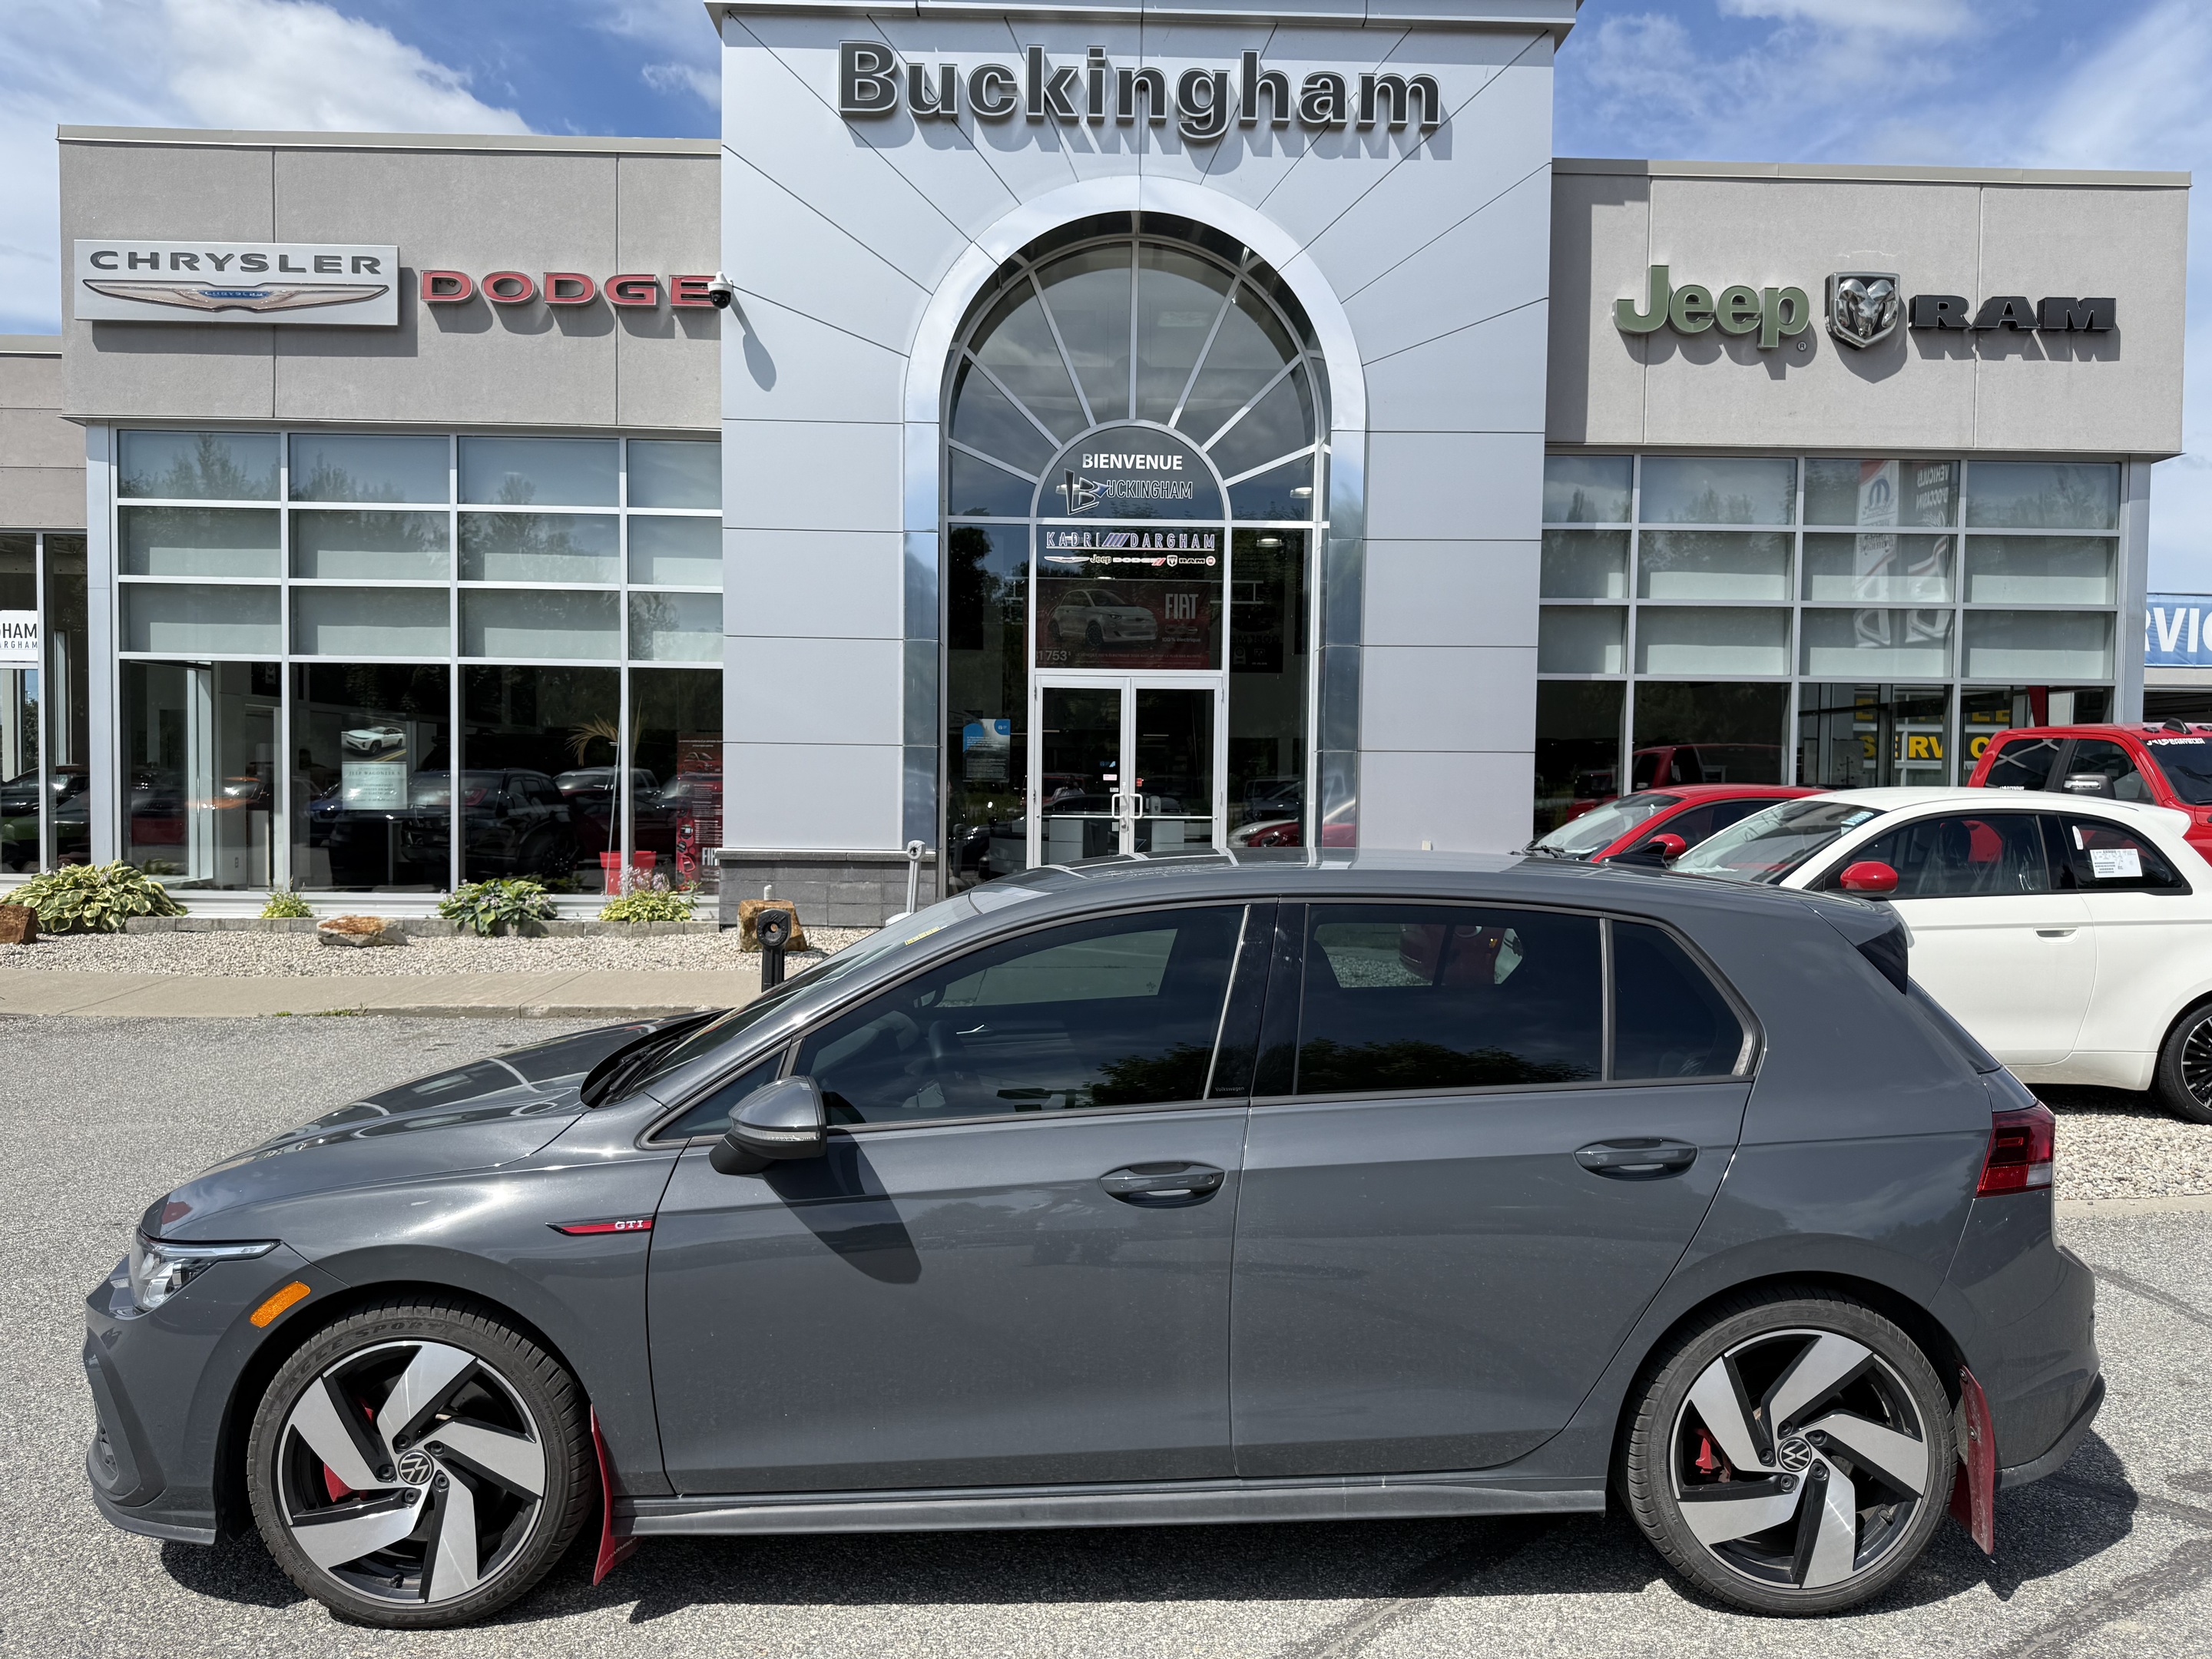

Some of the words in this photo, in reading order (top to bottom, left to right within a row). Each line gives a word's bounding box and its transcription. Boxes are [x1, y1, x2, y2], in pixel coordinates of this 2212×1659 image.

[839, 40, 1441, 143] Buckingham
[90, 250, 382, 275] CHRYSLER
[420, 270, 719, 309] DODGE
[1613, 265, 1810, 349] Jeep
[1909, 294, 2117, 333] RAM
[1082, 453, 1183, 470] BIENVENUE
[1046, 532, 1101, 547] KADRI
[1130, 533, 1215, 549] DARGHAM
[1089, 554, 1112, 565] Jeep
[1164, 593, 1199, 620] FIAT
[0, 623, 37, 638] HAM
[0, 641, 38, 649] RGHAM
[614, 1220, 644, 1230] GTI
